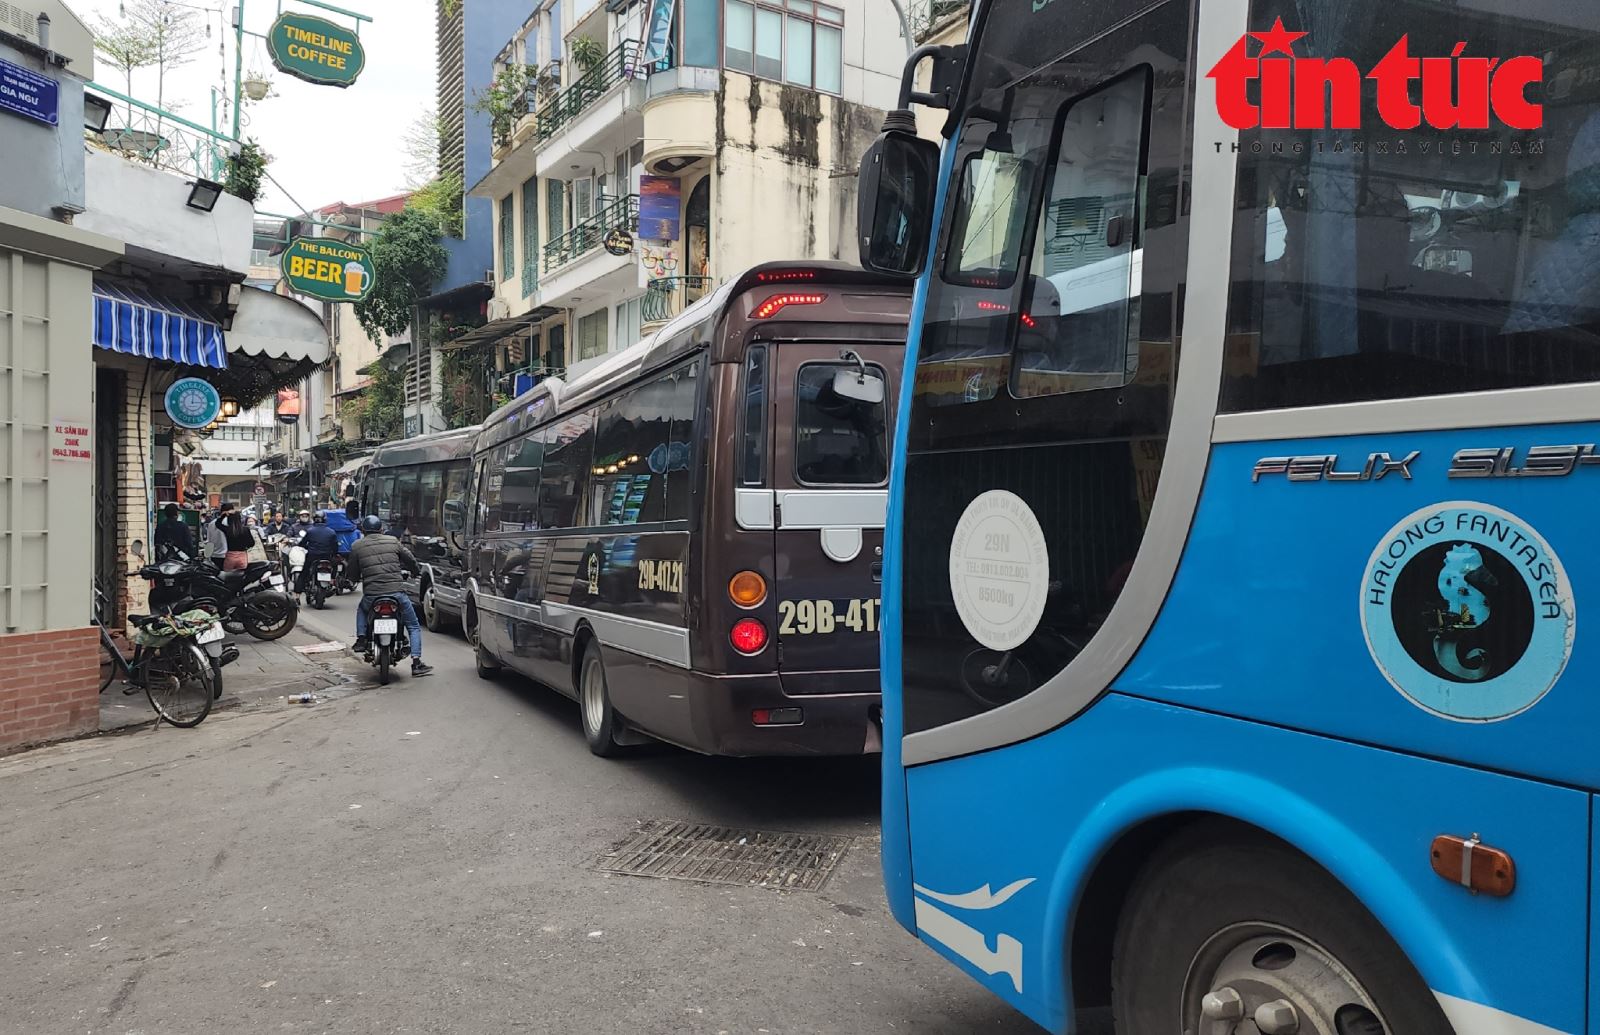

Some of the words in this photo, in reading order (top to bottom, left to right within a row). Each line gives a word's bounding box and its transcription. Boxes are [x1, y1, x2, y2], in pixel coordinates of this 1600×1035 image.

[283, 24, 353, 55] TIMELINE
[287, 43, 347, 70] COFFEE
[0, 84, 17, 98] GIA
[299, 242, 319, 253] THE
[319, 245, 364, 262] BALCONY
[290, 255, 343, 285] BEER
[1251, 450, 1421, 483] FELIX
[984, 533, 1011, 553] 29N
[638, 559, 683, 593] 29B-417.21
[1369, 515, 1445, 607] HALONG
[1455, 512, 1562, 620] FANTASEA
[979, 586, 1014, 608] 8500kg
